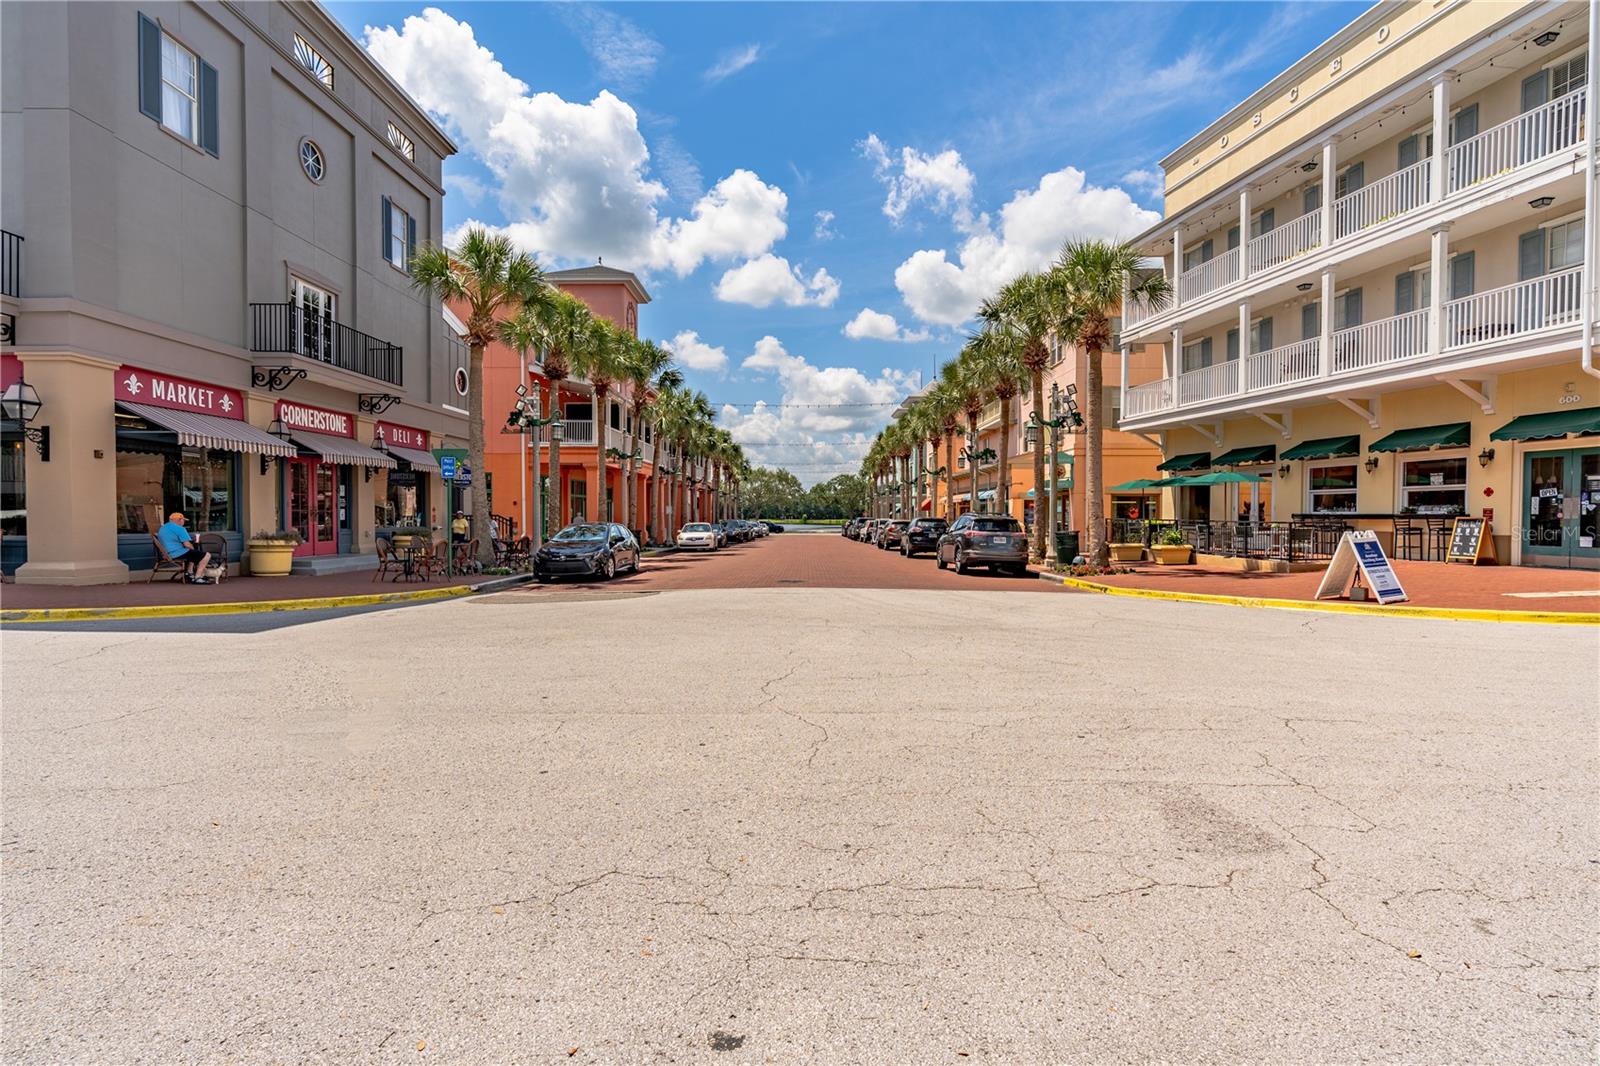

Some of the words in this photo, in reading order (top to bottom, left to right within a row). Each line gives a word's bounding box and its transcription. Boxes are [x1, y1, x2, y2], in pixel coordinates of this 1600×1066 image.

[152, 378, 214, 409] MARKET
[1559, 394, 1581, 404] 600
[280, 403, 347, 434] CORNERSTONE
[392, 428, 410, 444] DELI
[1541, 489, 1557, 497] OPEN
